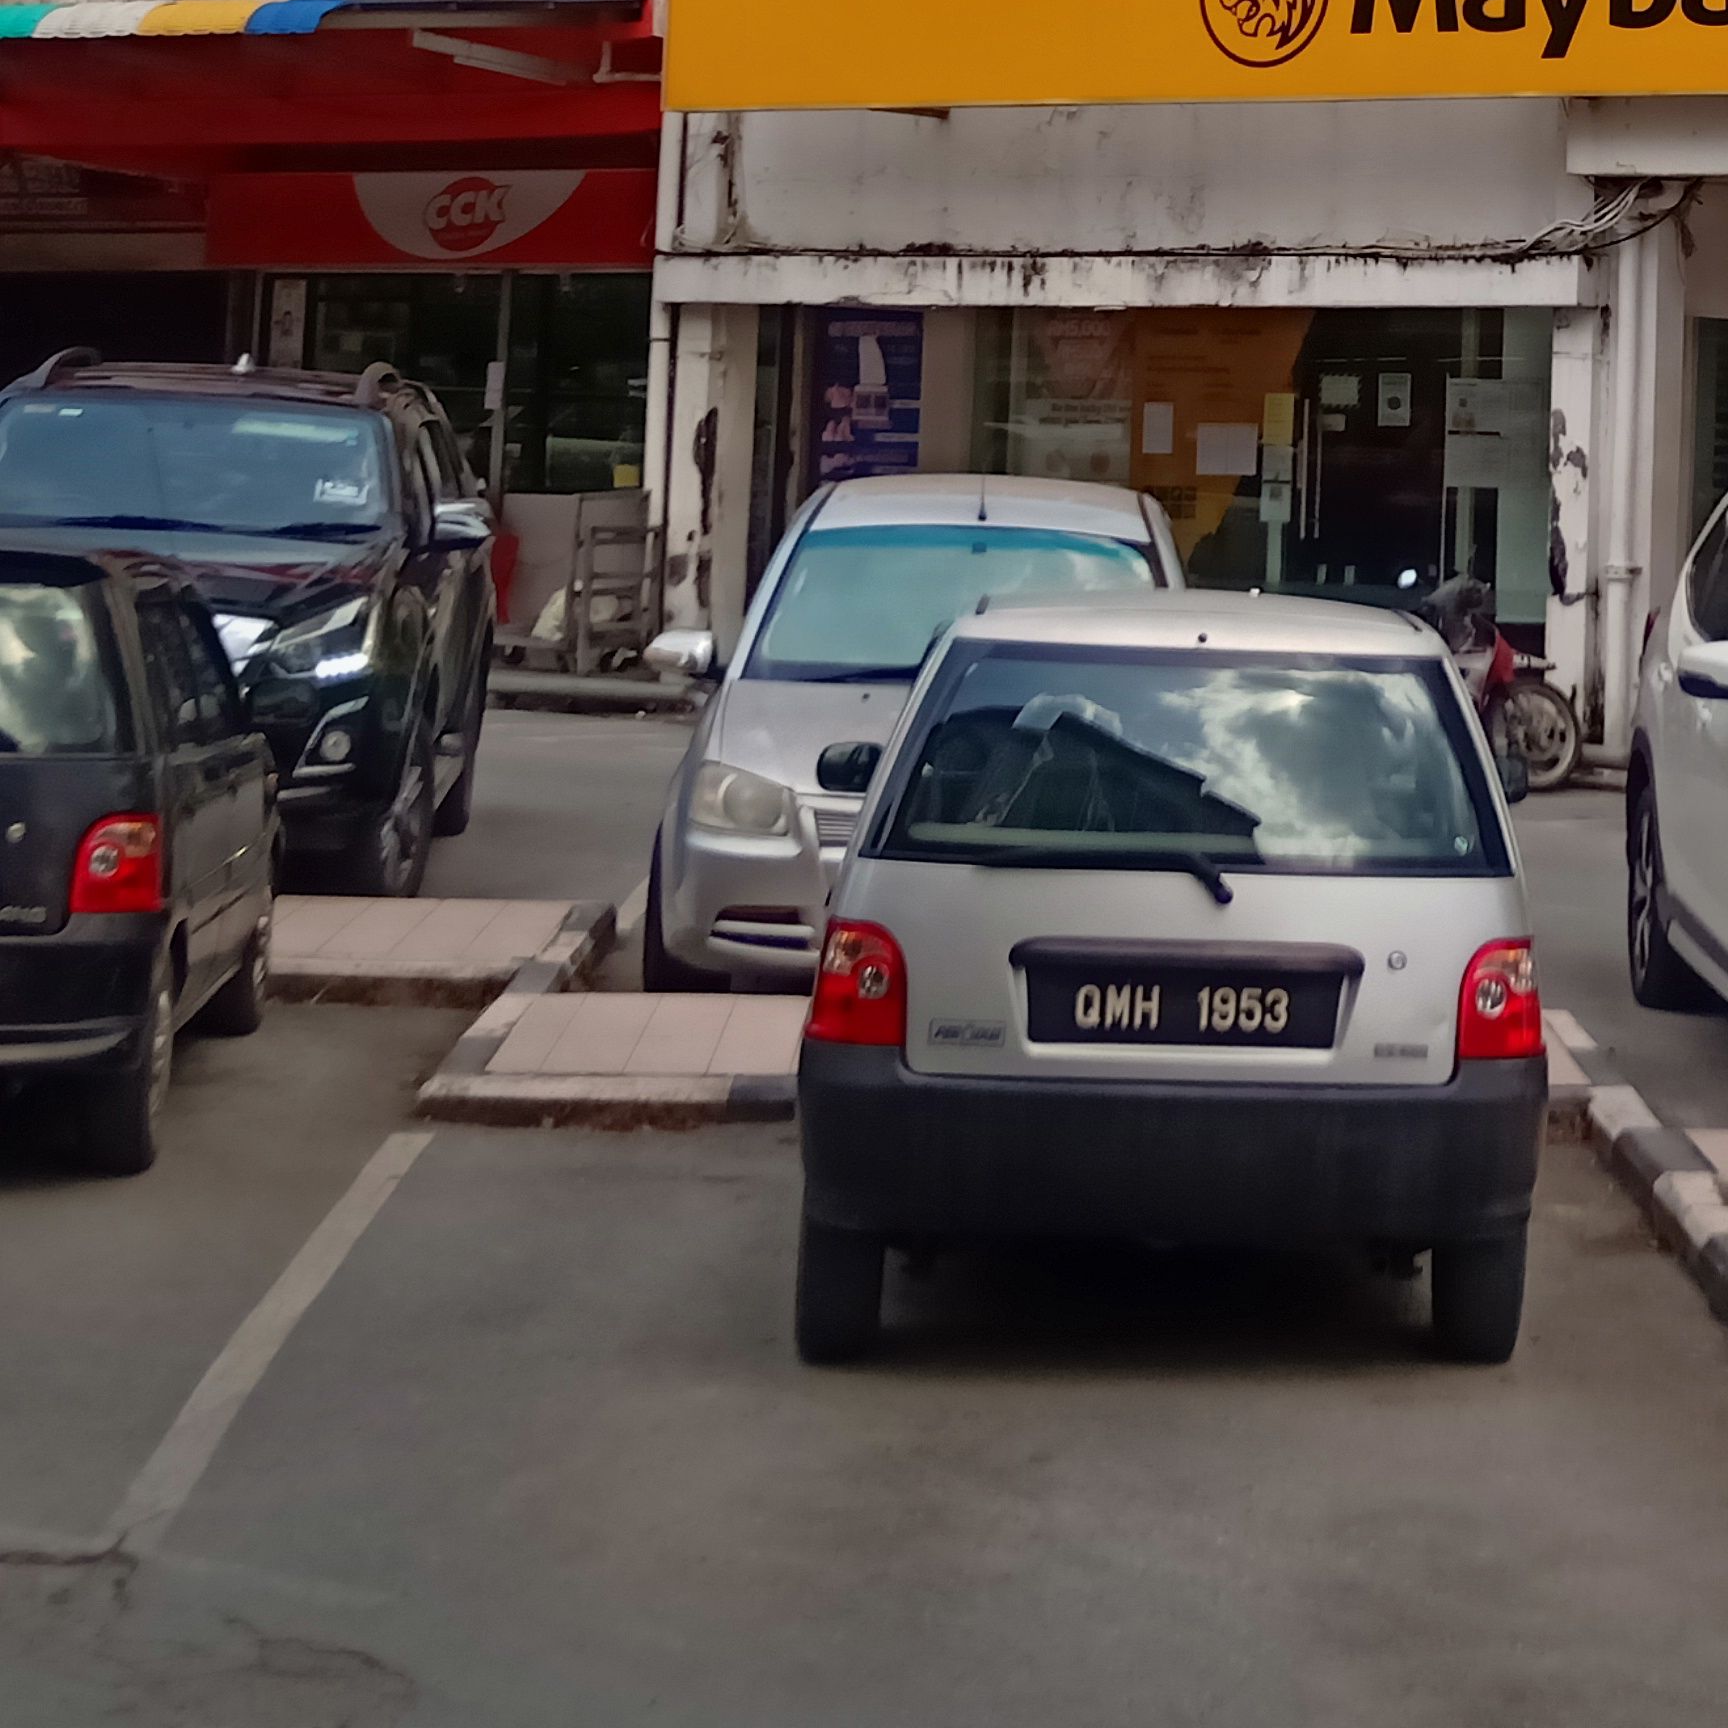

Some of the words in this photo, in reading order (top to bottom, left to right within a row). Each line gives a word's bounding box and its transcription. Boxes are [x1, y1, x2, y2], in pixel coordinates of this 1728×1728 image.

[426, 186, 506, 230] CCK
[1075, 984, 1160, 1032] QMH
[1198, 986, 1290, 1034] 1953
